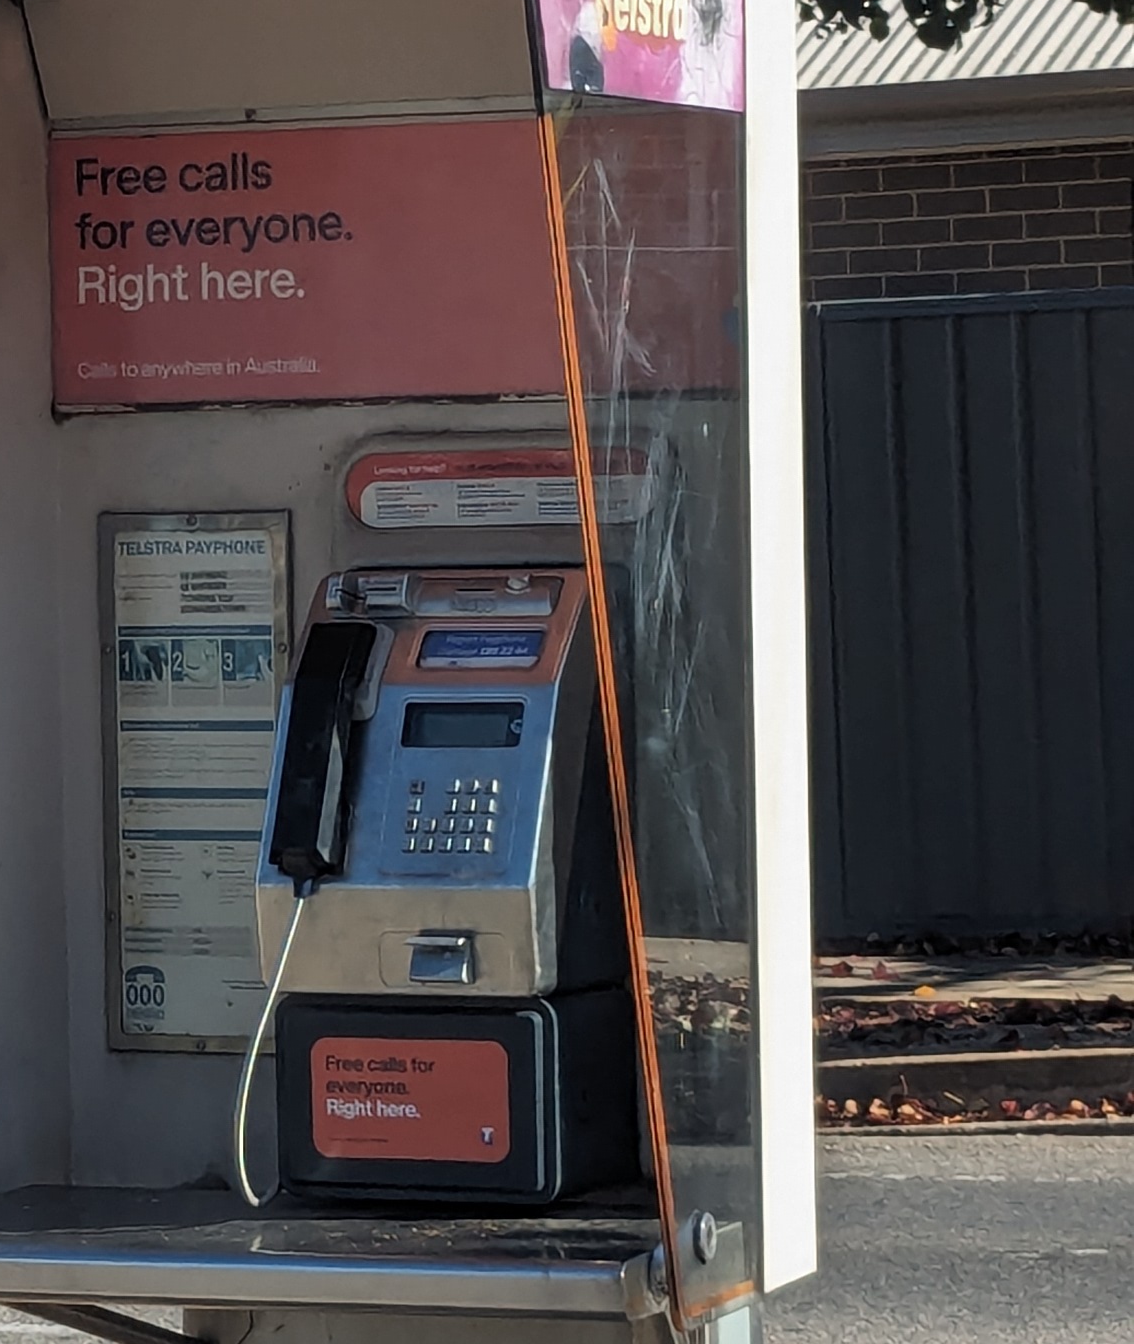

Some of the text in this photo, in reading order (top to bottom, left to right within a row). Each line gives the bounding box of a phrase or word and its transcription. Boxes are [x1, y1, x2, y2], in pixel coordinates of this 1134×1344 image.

[75, 152, 272, 196] Free calls
[75, 211, 354, 253] for everyone.
[78, 262, 306, 311] Right here.
[120, 360, 139, 377] to
[141, 360, 222, 379] anywhere
[226, 358, 241, 375] in
[118, 539, 266, 556] TELSTRA PAYPHONE
[121, 652, 131, 672] 1
[172, 652, 183, 672] 2
[223, 651, 234, 672] 3
[126, 984, 165, 1007] 000
[325, 1055, 435, 1073] Free calls for
[326, 1080, 410, 1096] everyone.
[326, 1098, 421, 1120] Right here.
